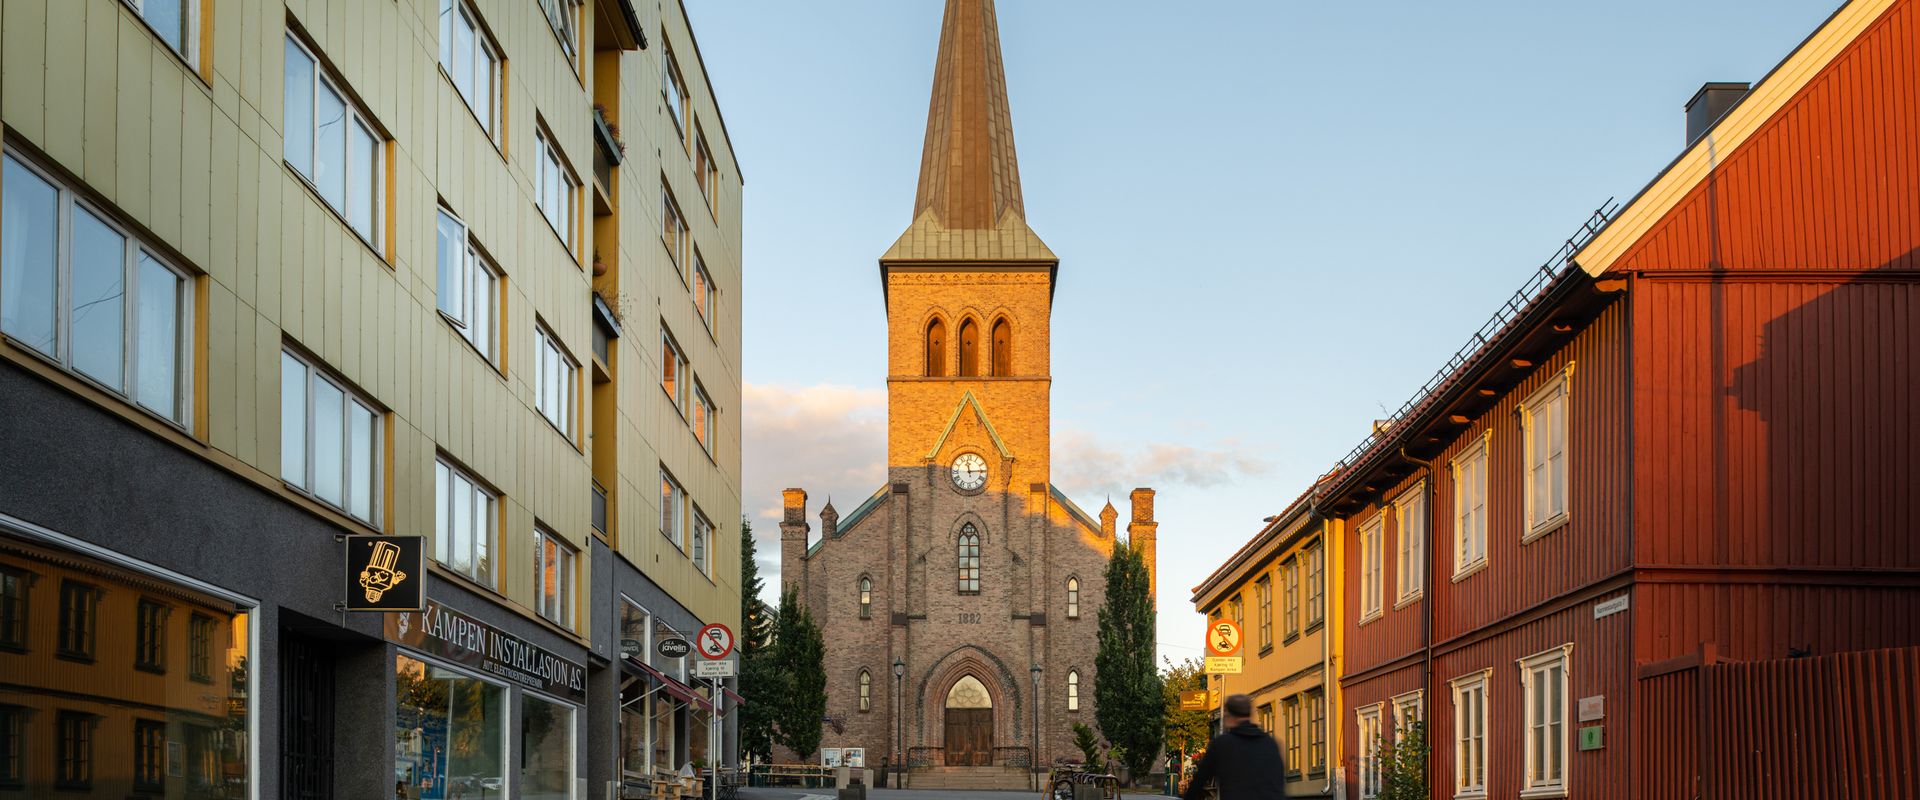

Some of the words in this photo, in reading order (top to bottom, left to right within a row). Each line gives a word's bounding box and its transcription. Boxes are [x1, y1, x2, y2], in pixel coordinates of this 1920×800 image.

[958, 612, 982, 624] 1882
[421, 605, 486, 655] KAMPEN
[490, 631, 568, 686] INSTALLASJON
[569, 666, 582, 691] AS
[662, 644, 687, 652] javelin
